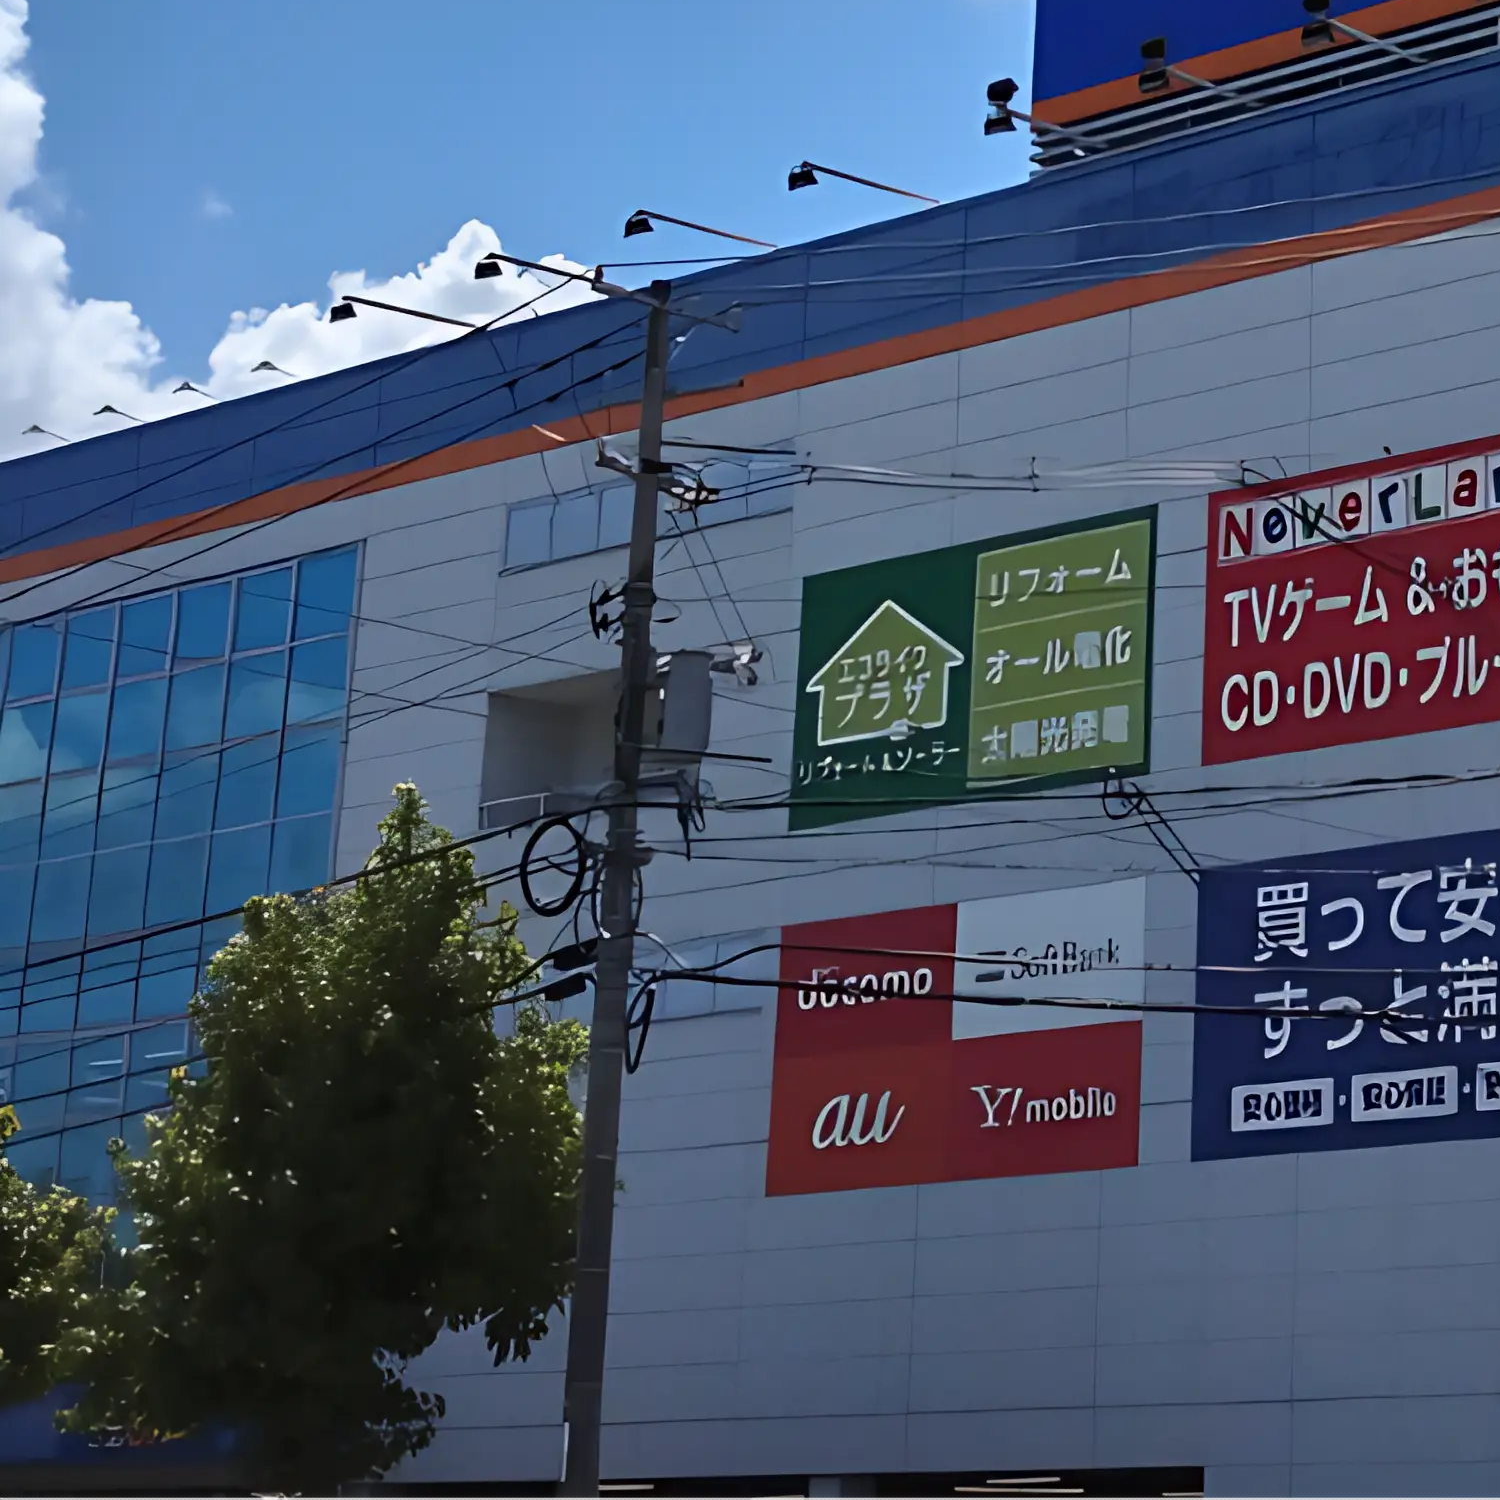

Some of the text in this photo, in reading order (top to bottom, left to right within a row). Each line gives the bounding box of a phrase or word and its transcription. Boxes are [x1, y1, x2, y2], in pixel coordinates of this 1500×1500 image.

[988, 547, 1133, 608] リフォーム
[984, 624, 1133, 685] オール化
[811, 1090, 906, 1150] au
